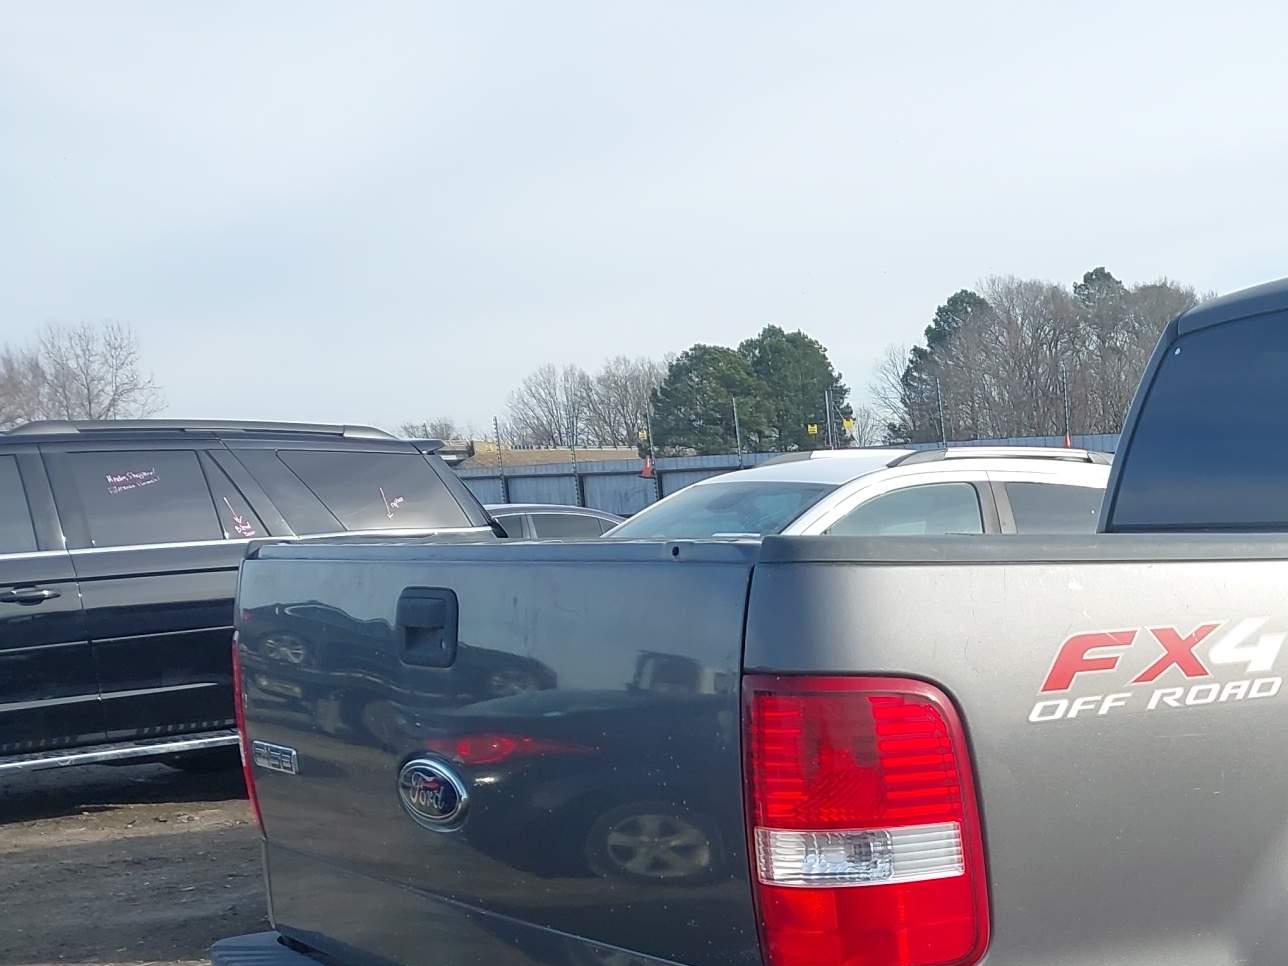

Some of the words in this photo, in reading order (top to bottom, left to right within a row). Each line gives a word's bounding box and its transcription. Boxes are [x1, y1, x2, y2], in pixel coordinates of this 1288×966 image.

[1038, 616, 1288, 694] FX4
[1028, 692, 1132, 722] OFF
[1146, 676, 1283, 710] ROAD
[408, 771, 446, 809] Ford
